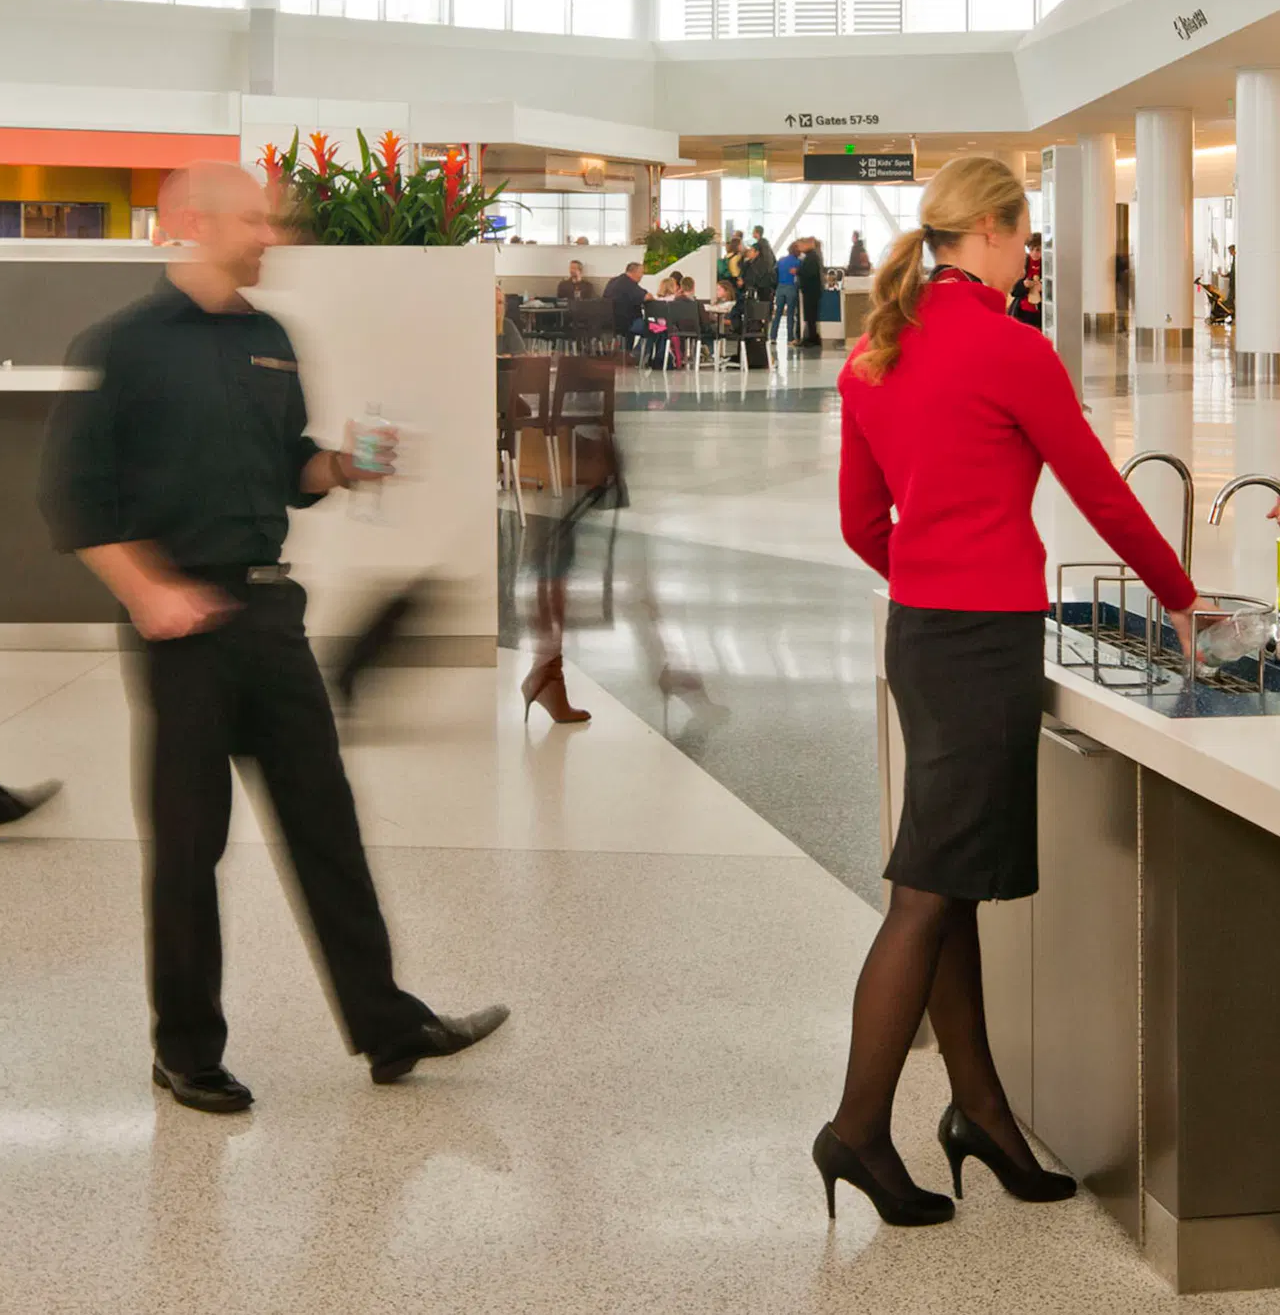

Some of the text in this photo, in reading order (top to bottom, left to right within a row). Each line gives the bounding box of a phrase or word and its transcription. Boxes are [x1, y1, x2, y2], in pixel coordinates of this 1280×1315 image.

[815, 115, 879, 126] Gates 57-59
[877, 168, 911, 176] Restrooms
